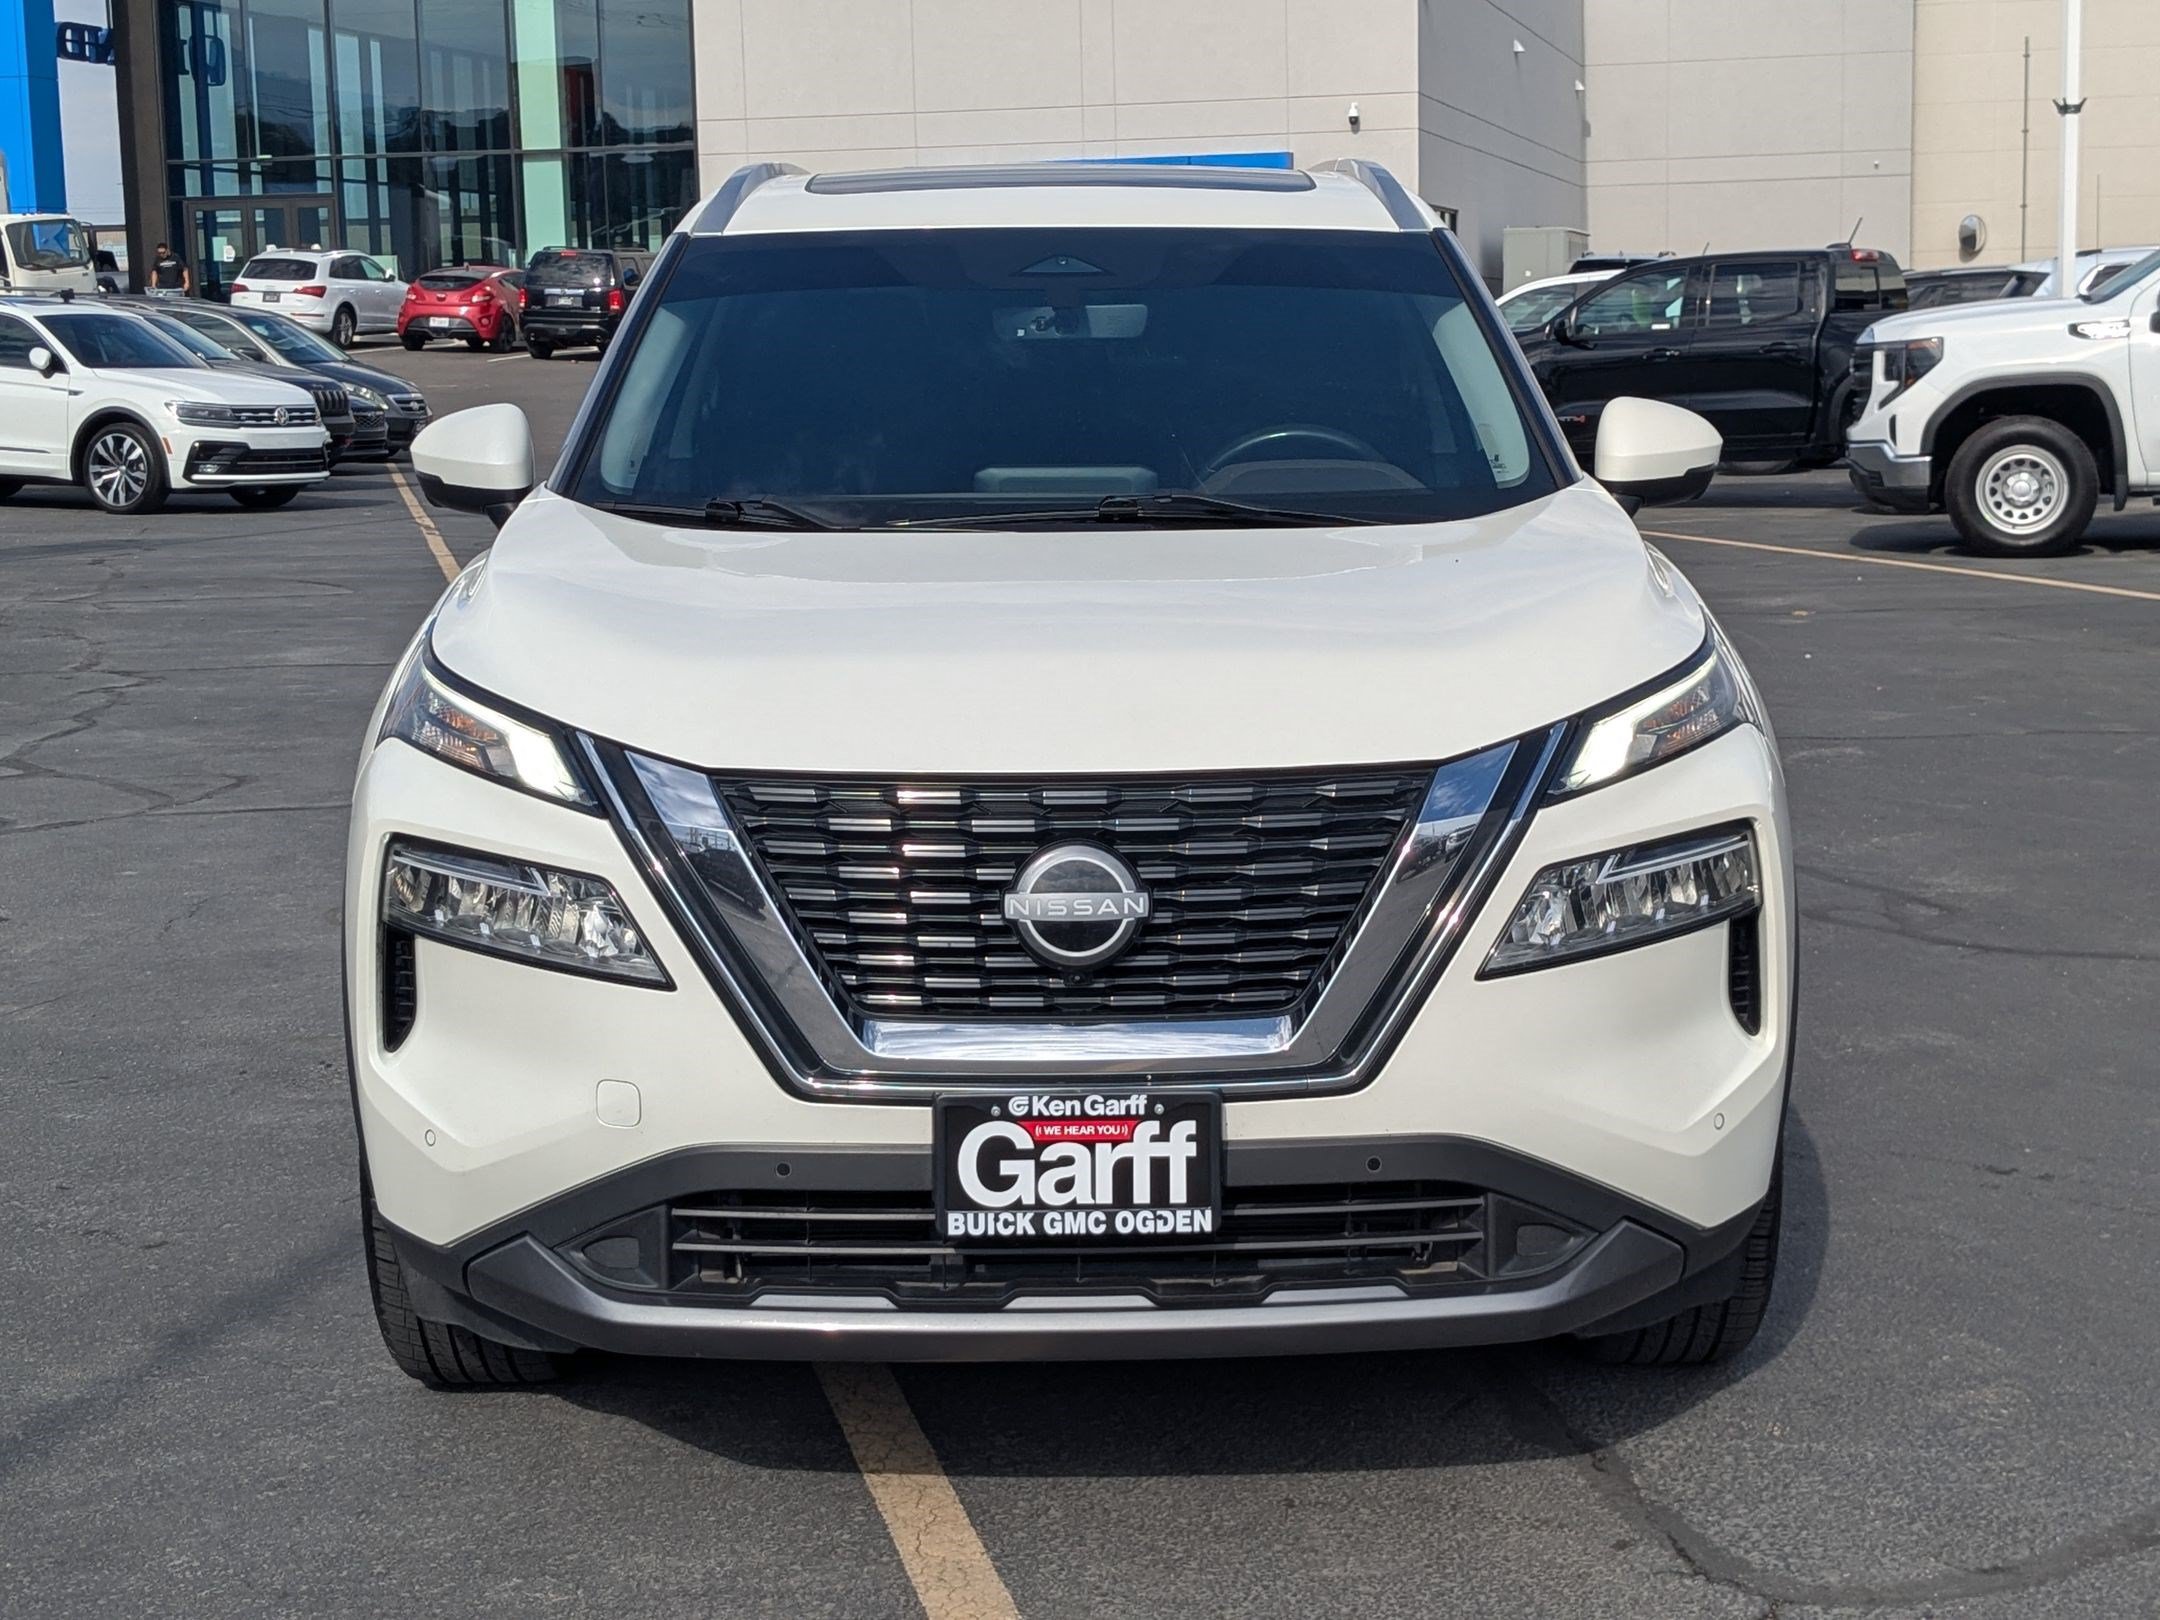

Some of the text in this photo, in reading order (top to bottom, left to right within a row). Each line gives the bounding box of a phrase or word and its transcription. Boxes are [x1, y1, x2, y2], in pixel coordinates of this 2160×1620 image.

[1009, 897, 1144, 916] NISSAN
[1032, 1094, 1147, 1116] Ken Garff
[1043, 1124, 1120, 1135] WE HEAR YOU
[957, 1120, 1197, 1207] Garff
[947, 1209, 1212, 1236] BUICK GMC OGDEN
